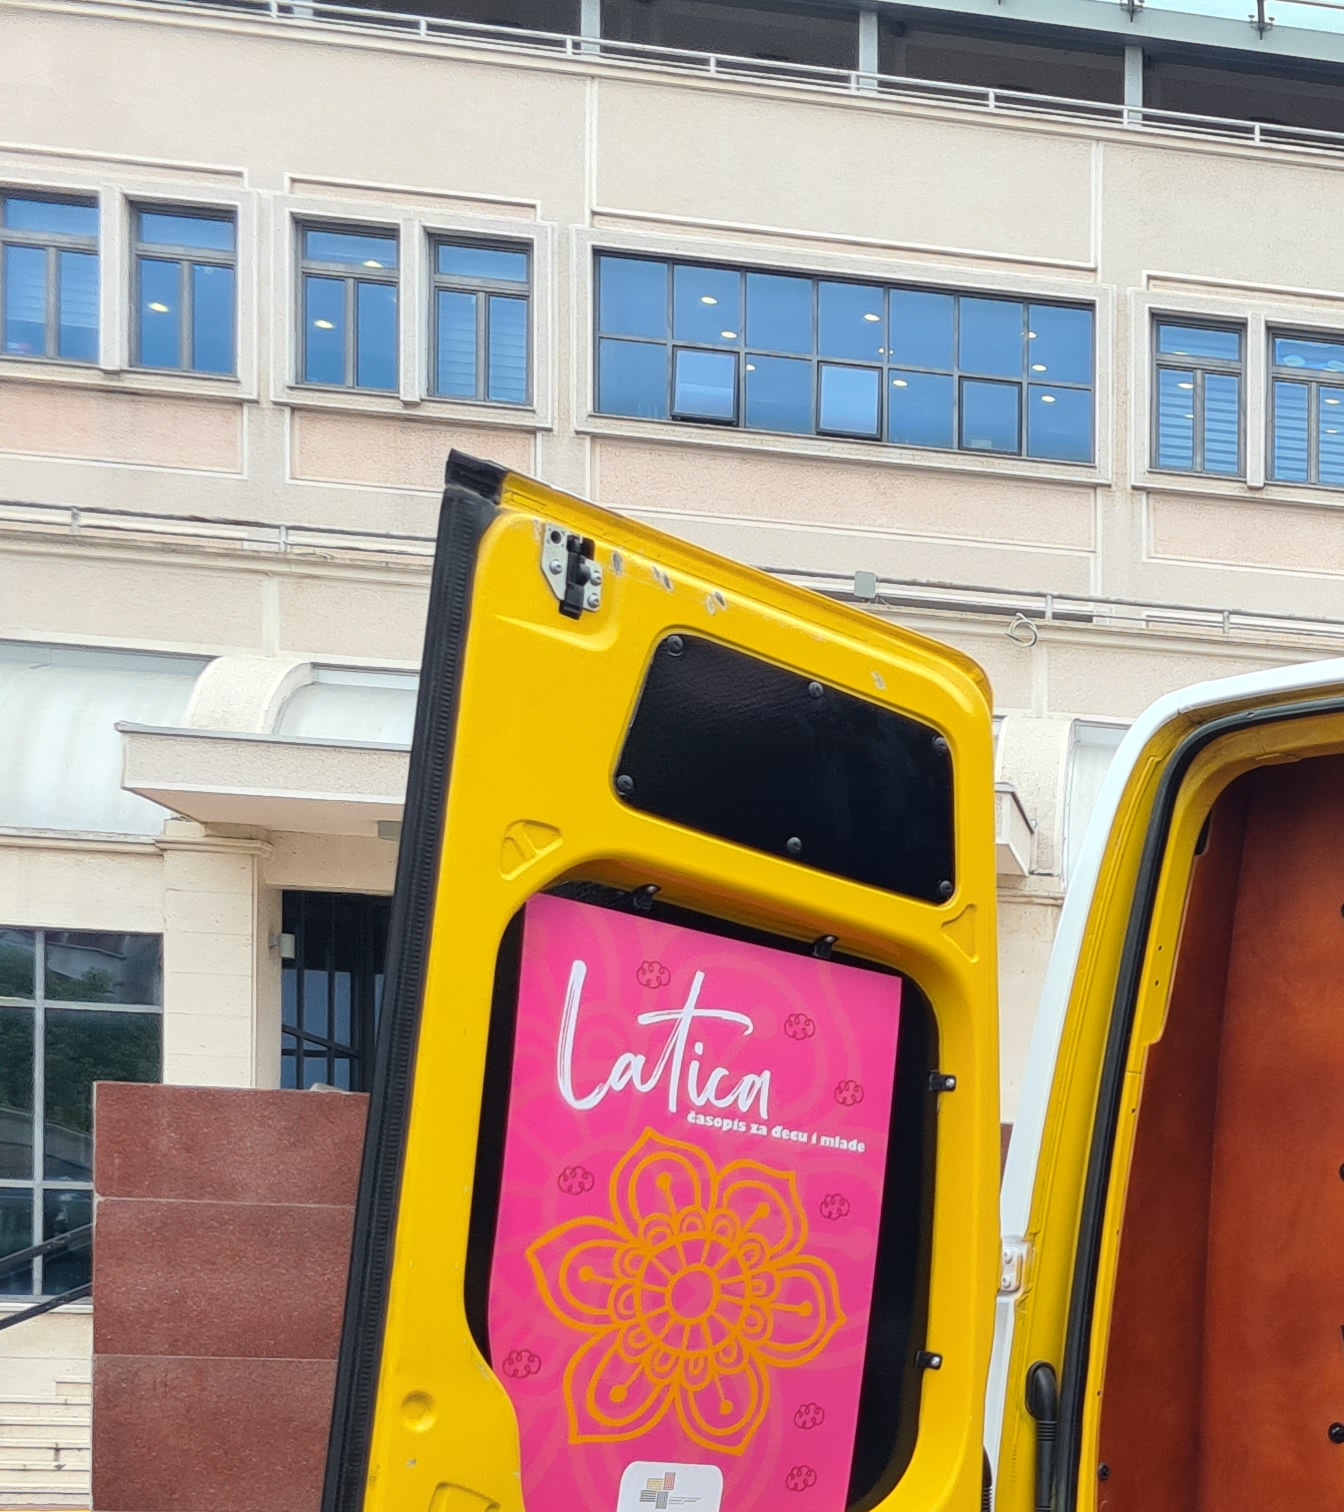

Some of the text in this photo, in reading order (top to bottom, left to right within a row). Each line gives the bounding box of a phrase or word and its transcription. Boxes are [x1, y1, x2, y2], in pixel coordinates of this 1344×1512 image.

[556, 959, 772, 1120] Latica
[687, 1110, 747, 1132] časopis
[750, 1123, 768, 1136] za
[811, 1131, 818, 1145] i
[820, 1135, 866, 1153] mlade
